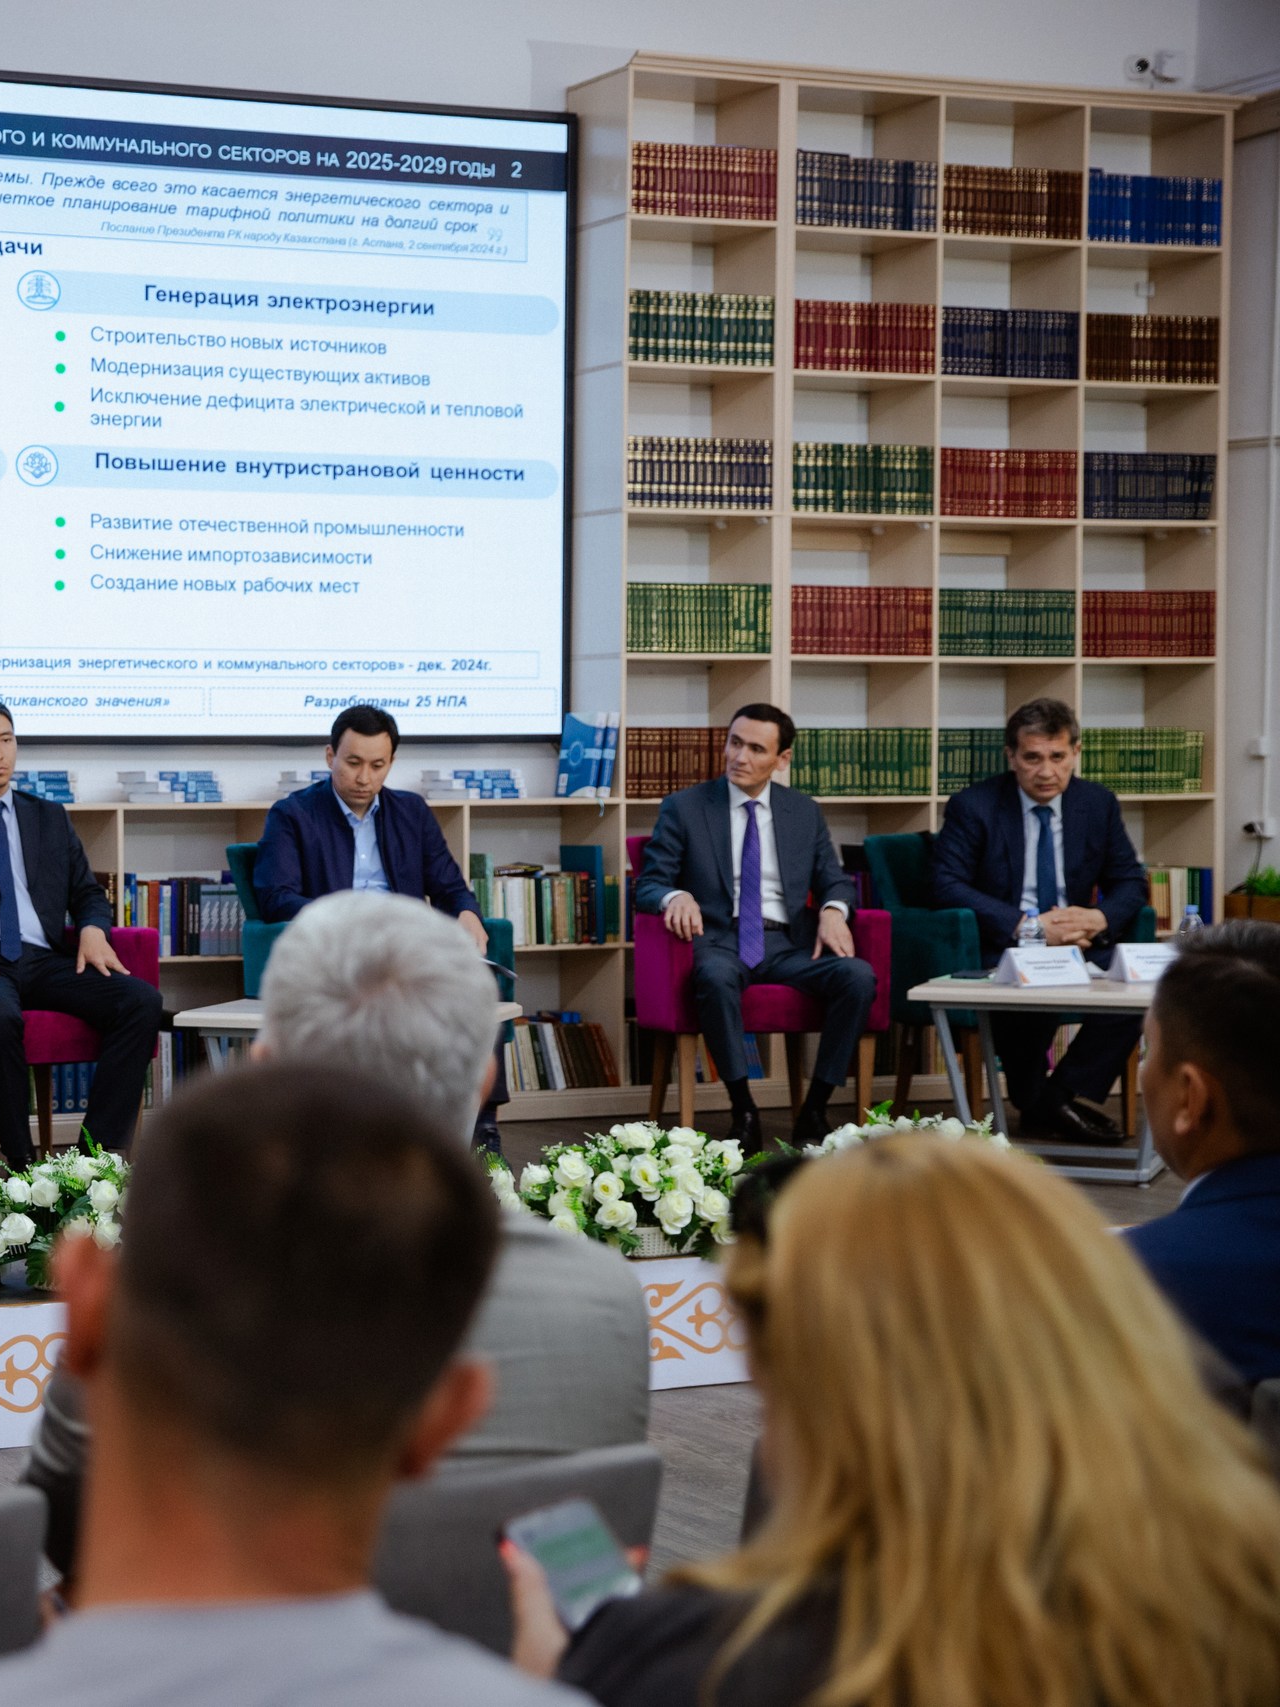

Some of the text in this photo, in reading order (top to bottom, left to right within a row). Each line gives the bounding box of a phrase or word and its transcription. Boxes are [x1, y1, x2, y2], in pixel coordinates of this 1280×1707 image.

[32, 131, 45, 147] И
[51, 132, 212, 159] КОММУНАЛЬНОГО
[218, 144, 311, 166] СЕКТОРОВ
[316, 151, 340, 167] НА
[345, 150, 447, 175] 2025-2029
[449, 160, 496, 180] ГОДЫ
[510, 161, 523, 179] 2
[41, 171, 106, 190] Прежде
[111, 179, 158, 193] всего
[163, 183, 197, 196] это
[201, 185, 279, 201] касается
[285, 191, 421, 210] энергетического
[428, 199, 494, 216] сектора
[499, 204, 509, 215] и
[62, 197, 178, 215] планирование
[185, 205, 271, 222] тарифной
[278, 211, 356, 226] политики
[361, 216, 380, 227] на
[384, 214, 438, 231] долгий
[444, 221, 478, 235] срок
[100, 222, 155, 235] Послание
[156, 224, 225, 240] Президента
[226, 229, 242, 240] РК
[243, 231, 282, 244] народу
[283, 233, 347, 245] Казахстана
[361, 238, 405, 251] Астана,
[417, 241, 468, 254] сентября
[469, 243, 495, 255] 2024
[144, 284, 434, 317] Генерация электроэнергии
[90, 326, 387, 355] Строительство новых источников
[90, 356, 431, 387] Модернизация существующих активов
[90, 387, 524, 419] Исключение дефицита электрической и тепловой
[90, 413, 162, 430] энергии
[95, 452, 525, 482] Повышение внутристрановой ценности
[90, 513, 465, 538] Развитие отечественной промышленности
[90, 543, 373, 566] Снижение импортозависимости
[90, 573, 360, 595] Создание новых рабочих мест
[78, 659, 198, 671] энергетического
[204, 660, 212, 670] и
[217, 660, 328, 673] коммунального
[332, 660, 405, 673] секторов»
[416, 661, 447, 673] дек.
[451, 658, 492, 671] 2024г.
[95, 696, 170, 708] значения»
[304, 695, 467, 709] Разработаны 25 НПА
